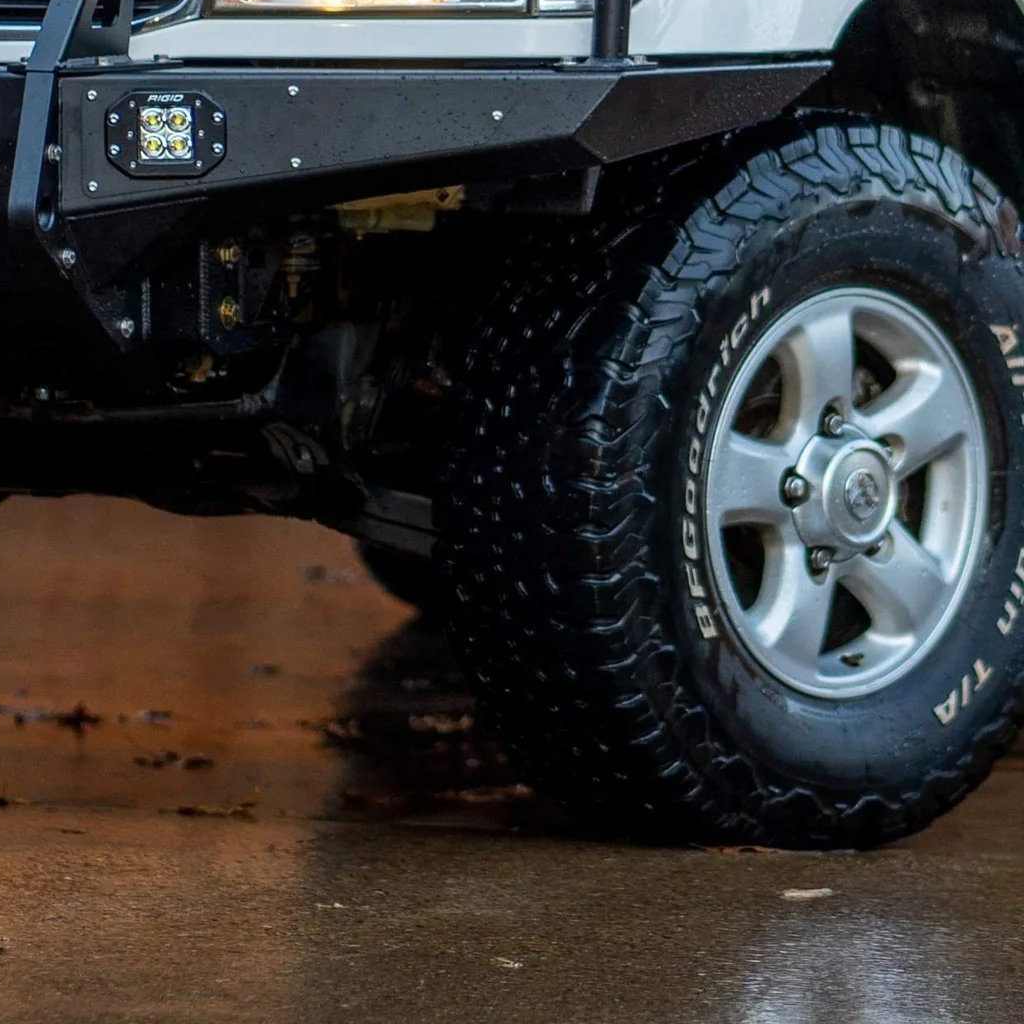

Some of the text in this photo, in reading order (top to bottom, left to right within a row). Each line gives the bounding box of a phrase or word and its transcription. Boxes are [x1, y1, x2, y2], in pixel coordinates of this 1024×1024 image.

[147, 94, 184, 102] RIGID
[682, 285, 770, 639] BFGoodrich
[933, 658, 993, 725] T/A
